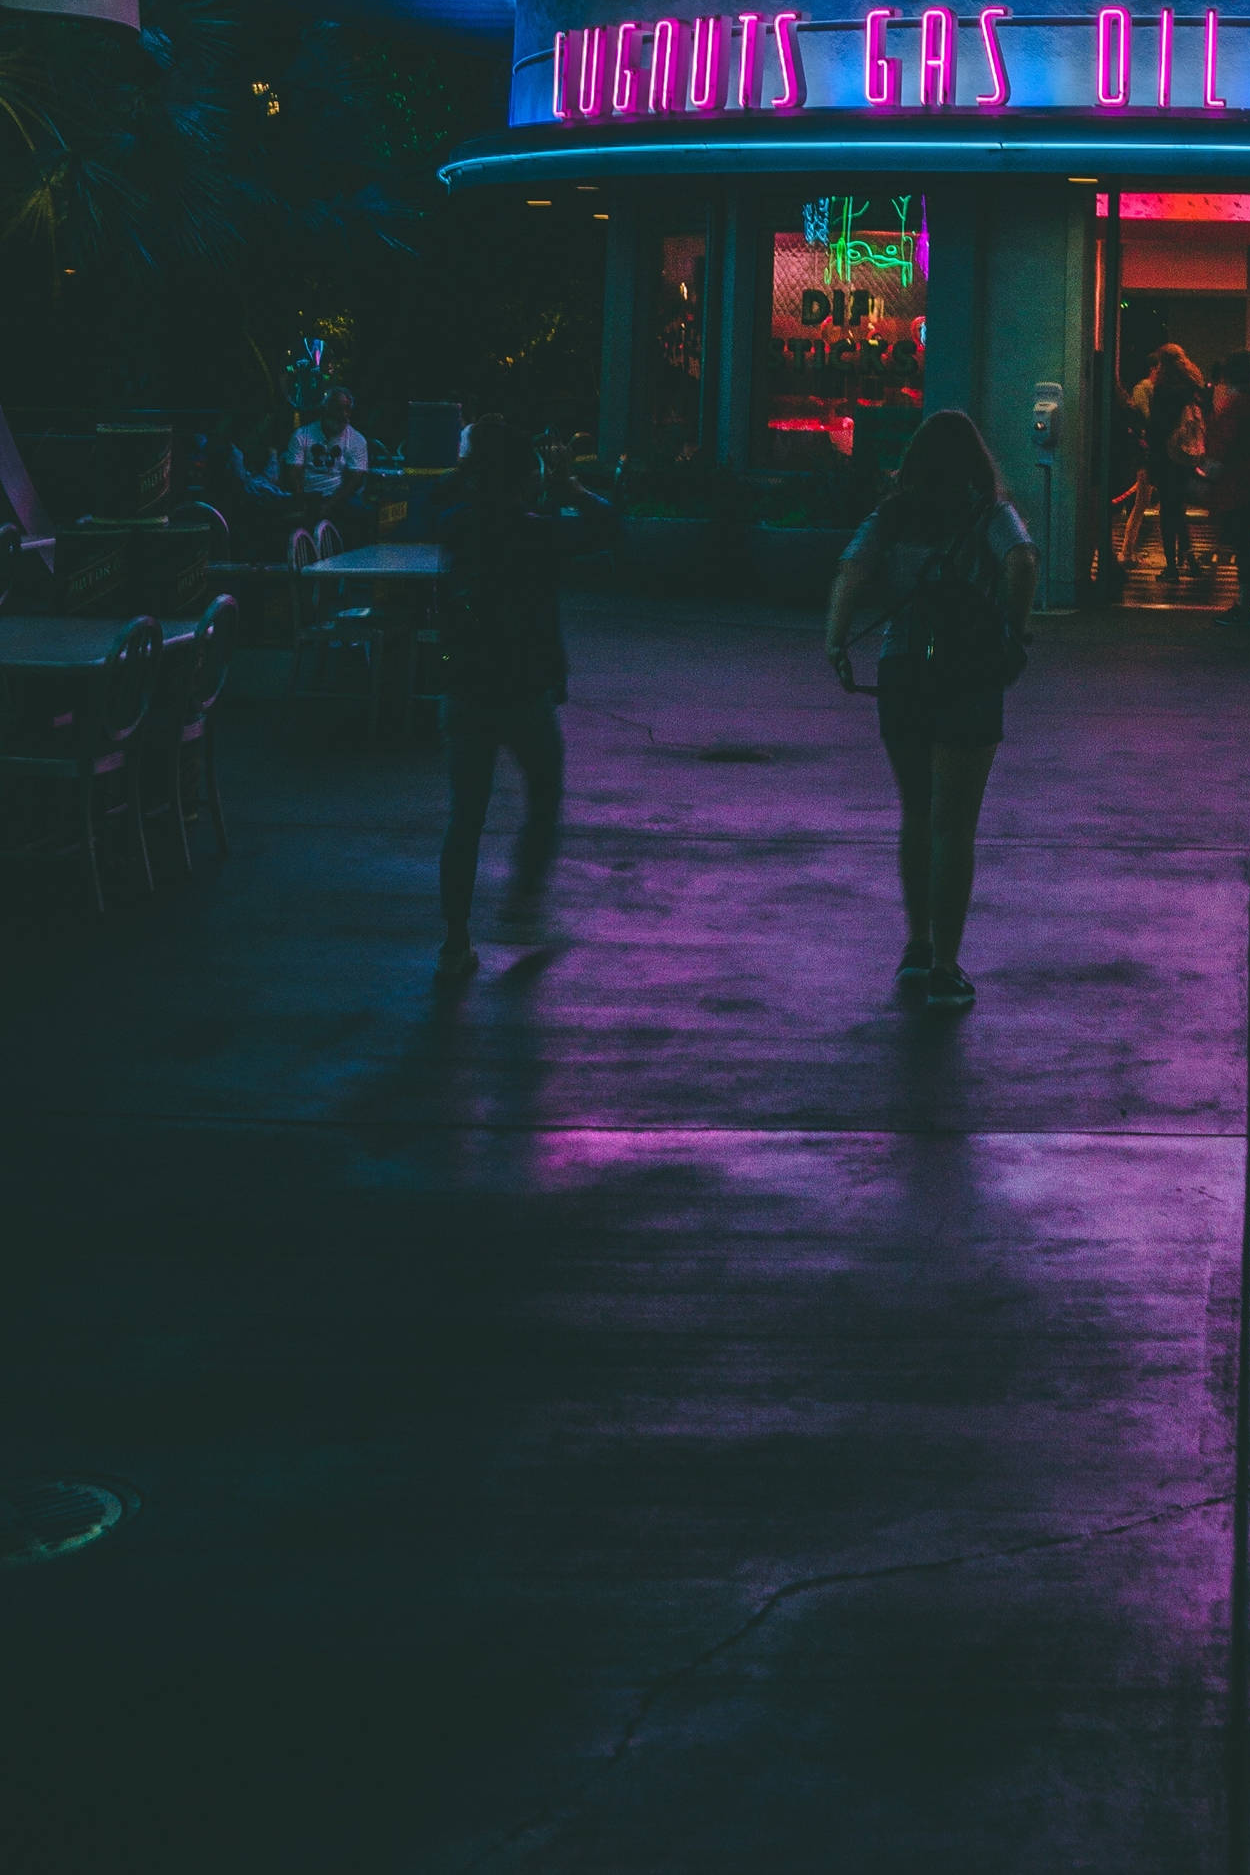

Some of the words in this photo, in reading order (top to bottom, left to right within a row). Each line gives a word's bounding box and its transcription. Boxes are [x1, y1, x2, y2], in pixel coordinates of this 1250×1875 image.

[552, 11, 804, 120] LUGNUTS
[864, 5, 1011, 107] GAS
[1097, 5, 1228, 108] OIL
[802, 289, 871, 326] DIP
[768, 338, 919, 374] STICKS
